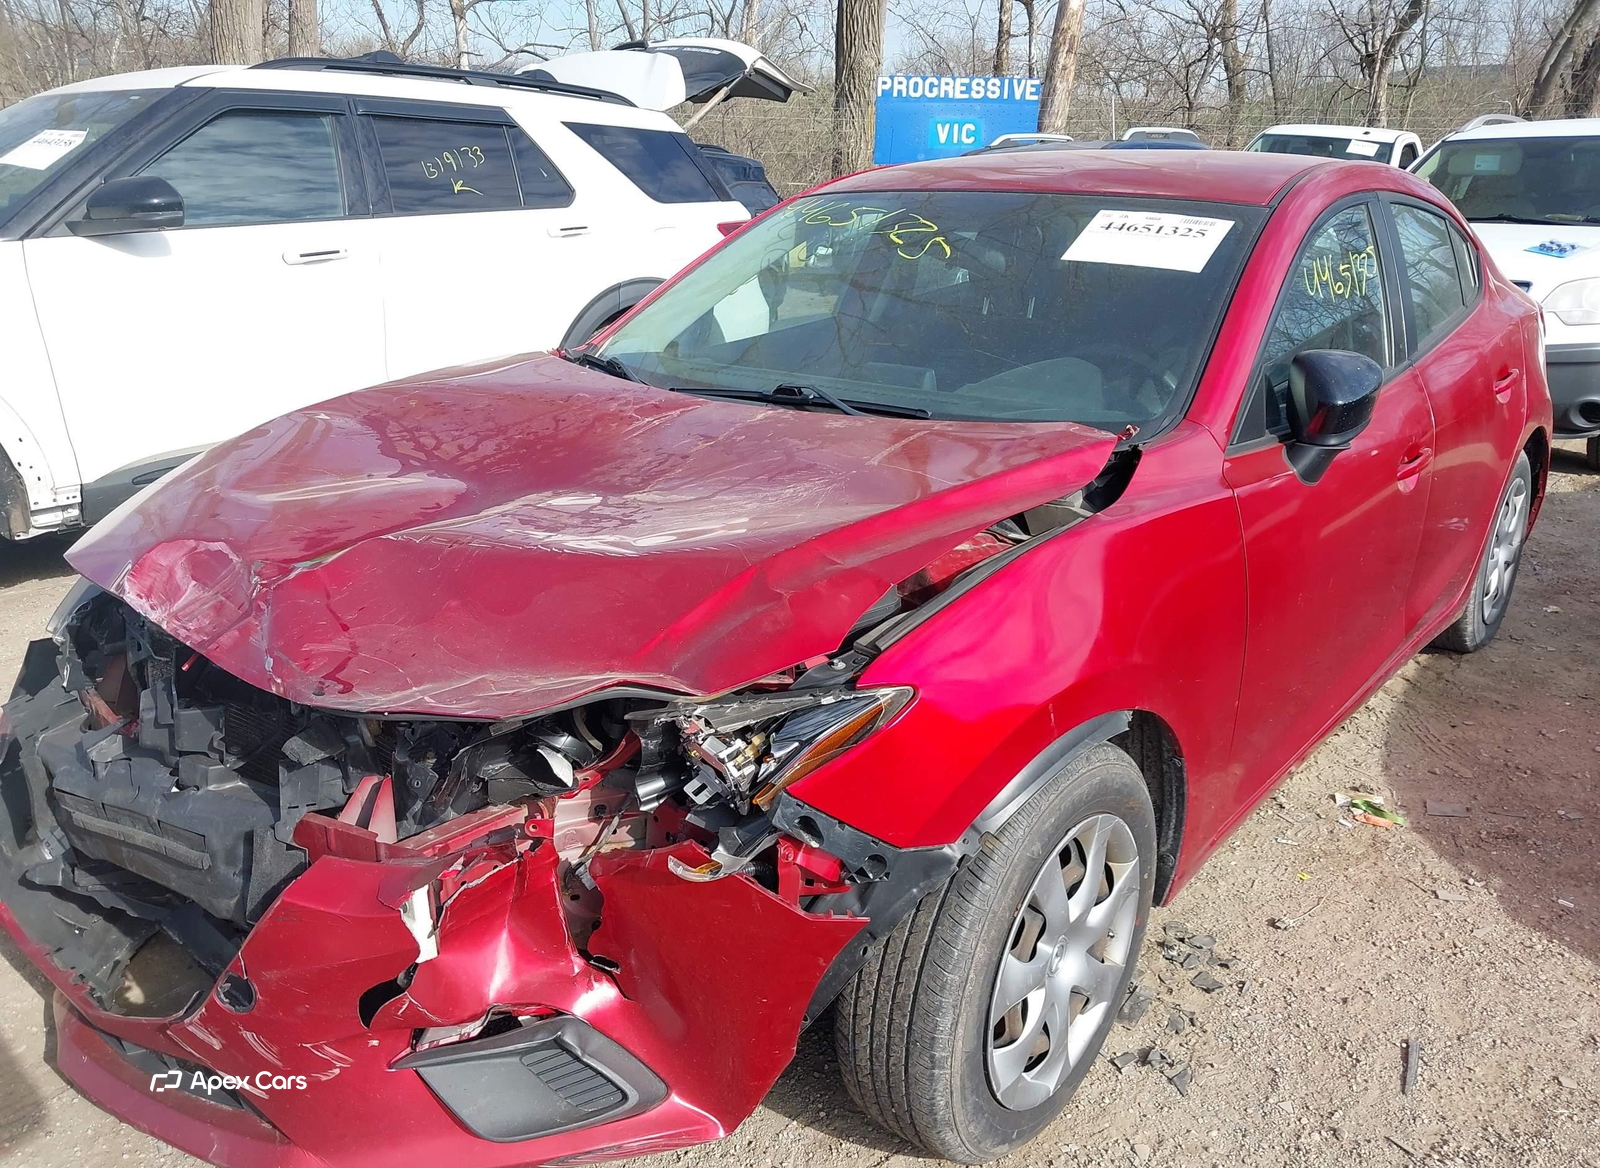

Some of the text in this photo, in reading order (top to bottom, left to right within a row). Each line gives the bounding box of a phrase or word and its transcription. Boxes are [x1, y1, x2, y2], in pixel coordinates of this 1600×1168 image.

[876, 76, 1041, 100] PROGRESSIVE
[936, 122, 976, 144] VIC
[1099, 221, 1209, 240] 44651325
